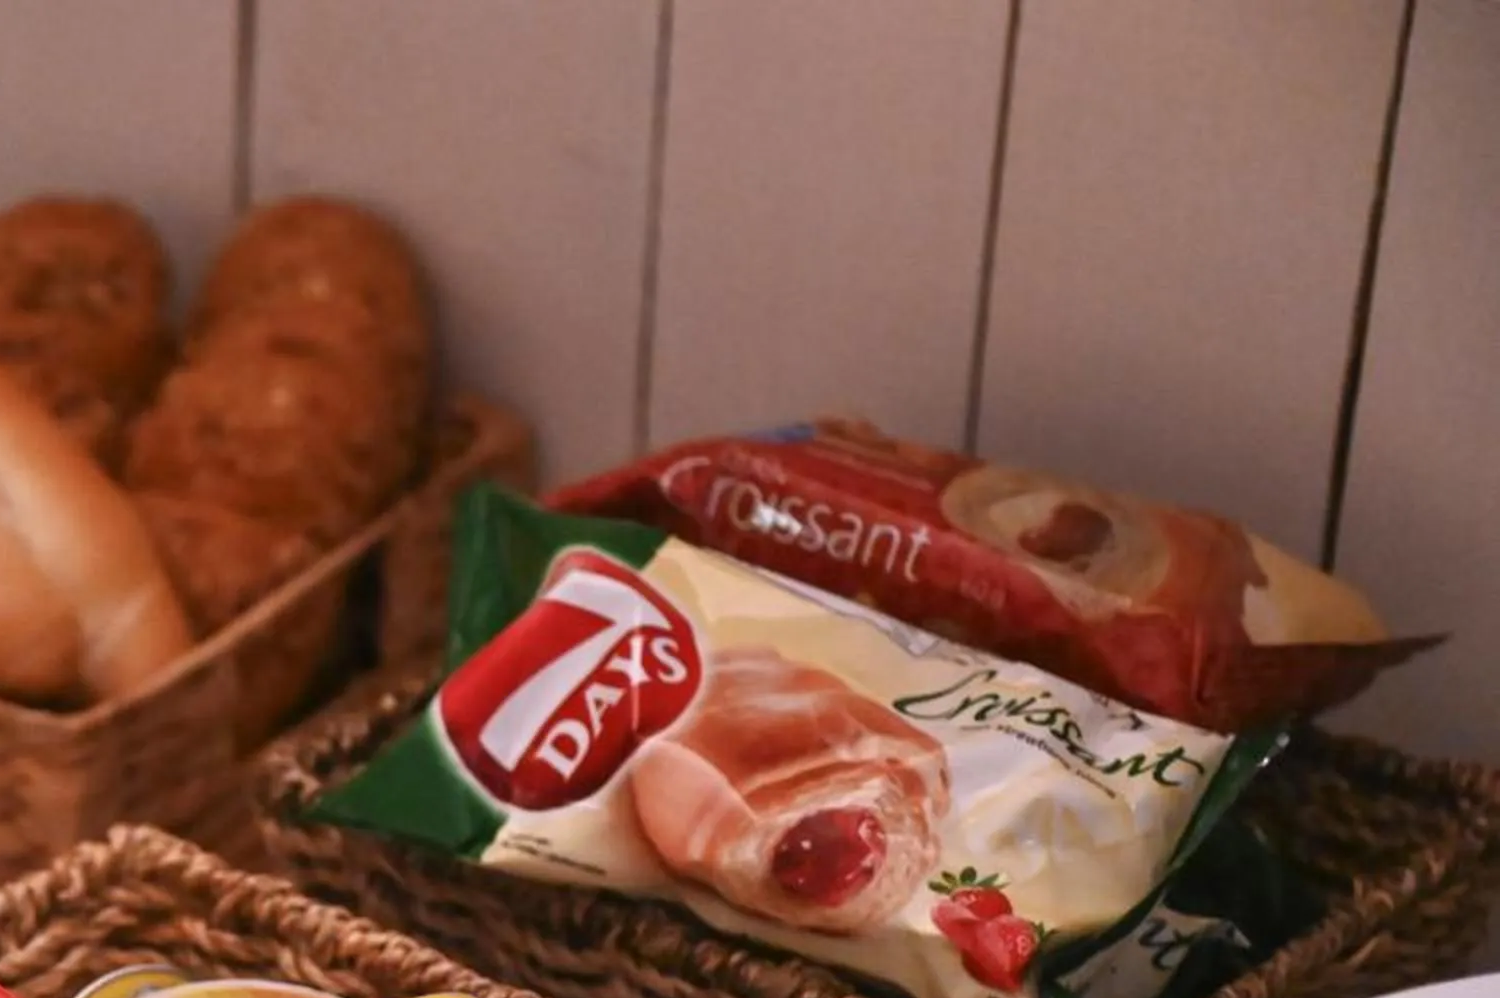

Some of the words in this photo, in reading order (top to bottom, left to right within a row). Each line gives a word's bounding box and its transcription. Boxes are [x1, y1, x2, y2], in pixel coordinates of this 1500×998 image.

[481, 568, 666, 772] 7
[534, 634, 688, 781] DAYS
[893, 669, 1206, 788] Croissant
